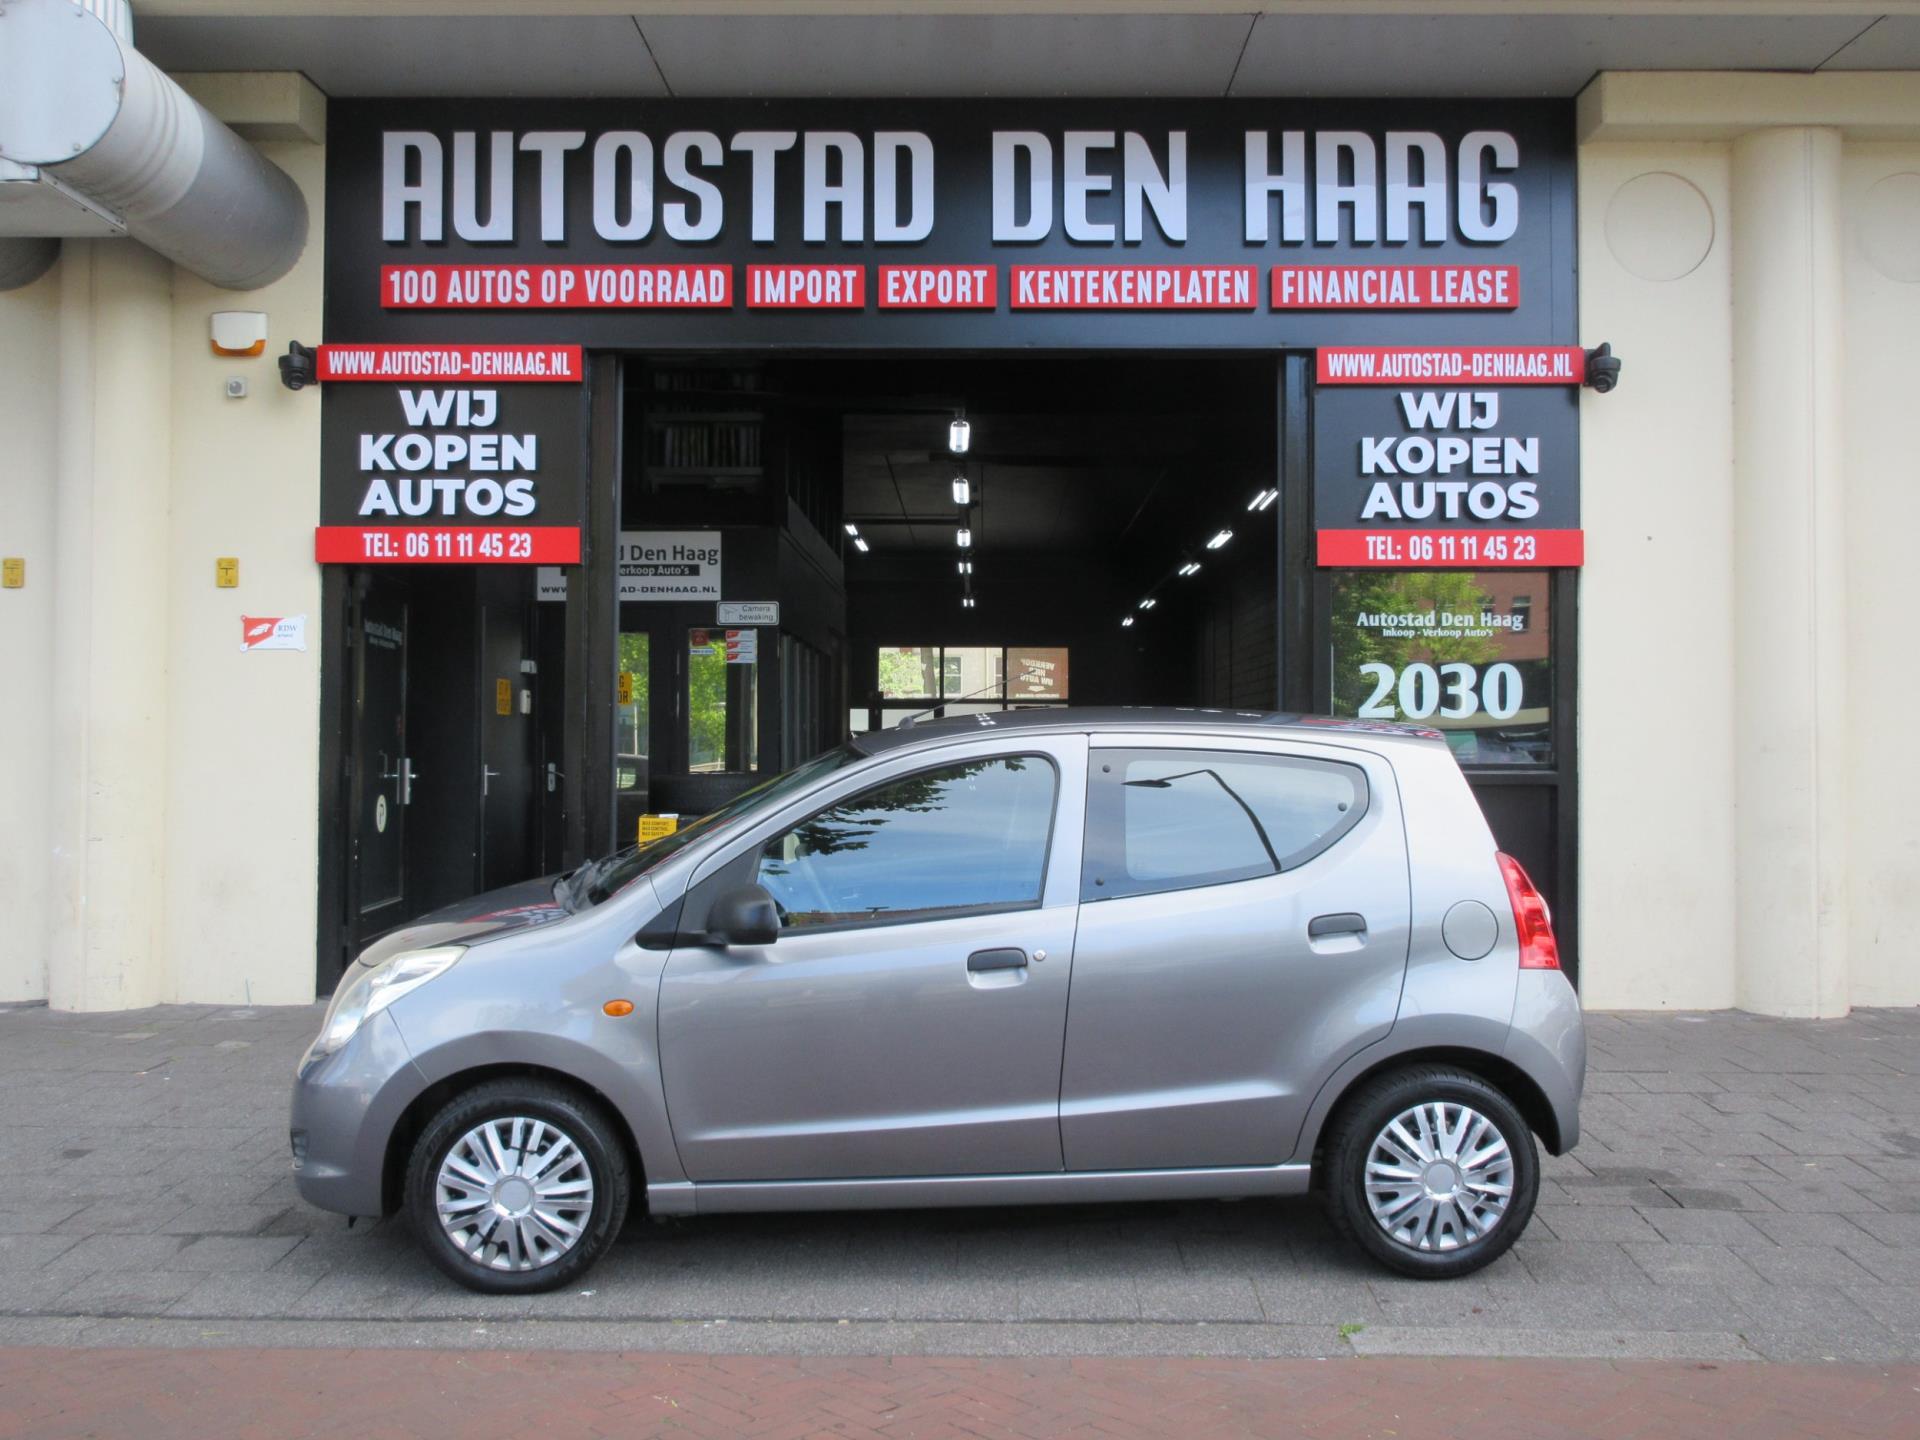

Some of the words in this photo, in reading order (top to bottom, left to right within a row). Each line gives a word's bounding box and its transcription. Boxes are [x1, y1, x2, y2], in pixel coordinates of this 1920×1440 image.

[382, 132, 934, 241] AUTOSTAD
[993, 132, 1187, 241] DEN
[1246, 132, 1519, 242] HAAG
[390, 270, 437, 304] 100
[448, 270, 530, 304] AUTOS
[542, 270, 575, 304] OP
[585, 270, 725, 304] VOORRAAD
[754, 270, 857, 304] IMPORT
[887, 270, 988, 304] EXPORT
[1019, 270, 1249, 304] KENTEKENPLATEN
[1282, 270, 1421, 304] FINANCIAL
[1431, 270, 1509, 304] LEASE
[329, 352, 571, 375] WWW.AUTOSTAD-DENHAAG.NL
[1328, 353, 1573, 377] WWW.AUTOSTAD-DENHAAG.NL
[399, 390, 497, 426] WIJ
[1400, 392, 1499, 429] WIJ
[360, 434, 537, 471] KOPEN
[1362, 436, 1539, 473] KOPEN
[358, 479, 536, 516] AUTOS
[1361, 482, 1540, 519] AUTOS
[363, 533, 398, 557] TEL:
[405, 533, 429, 557] 06
[435, 533, 451, 557] 11
[457, 533, 473, 557] 11
[479, 533, 503, 557] 45
[509, 533, 531, 557] 23
[631, 545, 666, 561] Den
[673, 545, 719, 566] Haag
[1366, 536, 1401, 560] TEL:
[1409, 536, 1432, 560] 06
[1439, 536, 1455, 560] 11
[1461, 536, 1477, 560] 11
[1484, 536, 1507, 560] 45
[1514, 536, 1536, 560] 23
[619, 566, 655, 576] erkoop
[657, 565, 690, 575] Auto's
[620, 585, 718, 593] AD-DENHAAG.NL
[738, 613, 774, 622] bewaking
[742, 604, 770, 612] Camera
[1357, 611, 1435, 627] Autostad
[1442, 612, 1474, 627] Den
[1481, 612, 1523, 631] Haag
[1383, 628, 1415, 639] Inkoop
[1423, 628, 1462, 639] Verkoop
[1464, 628, 1494, 638] Auto's
[1358, 663, 1523, 720] 2030
